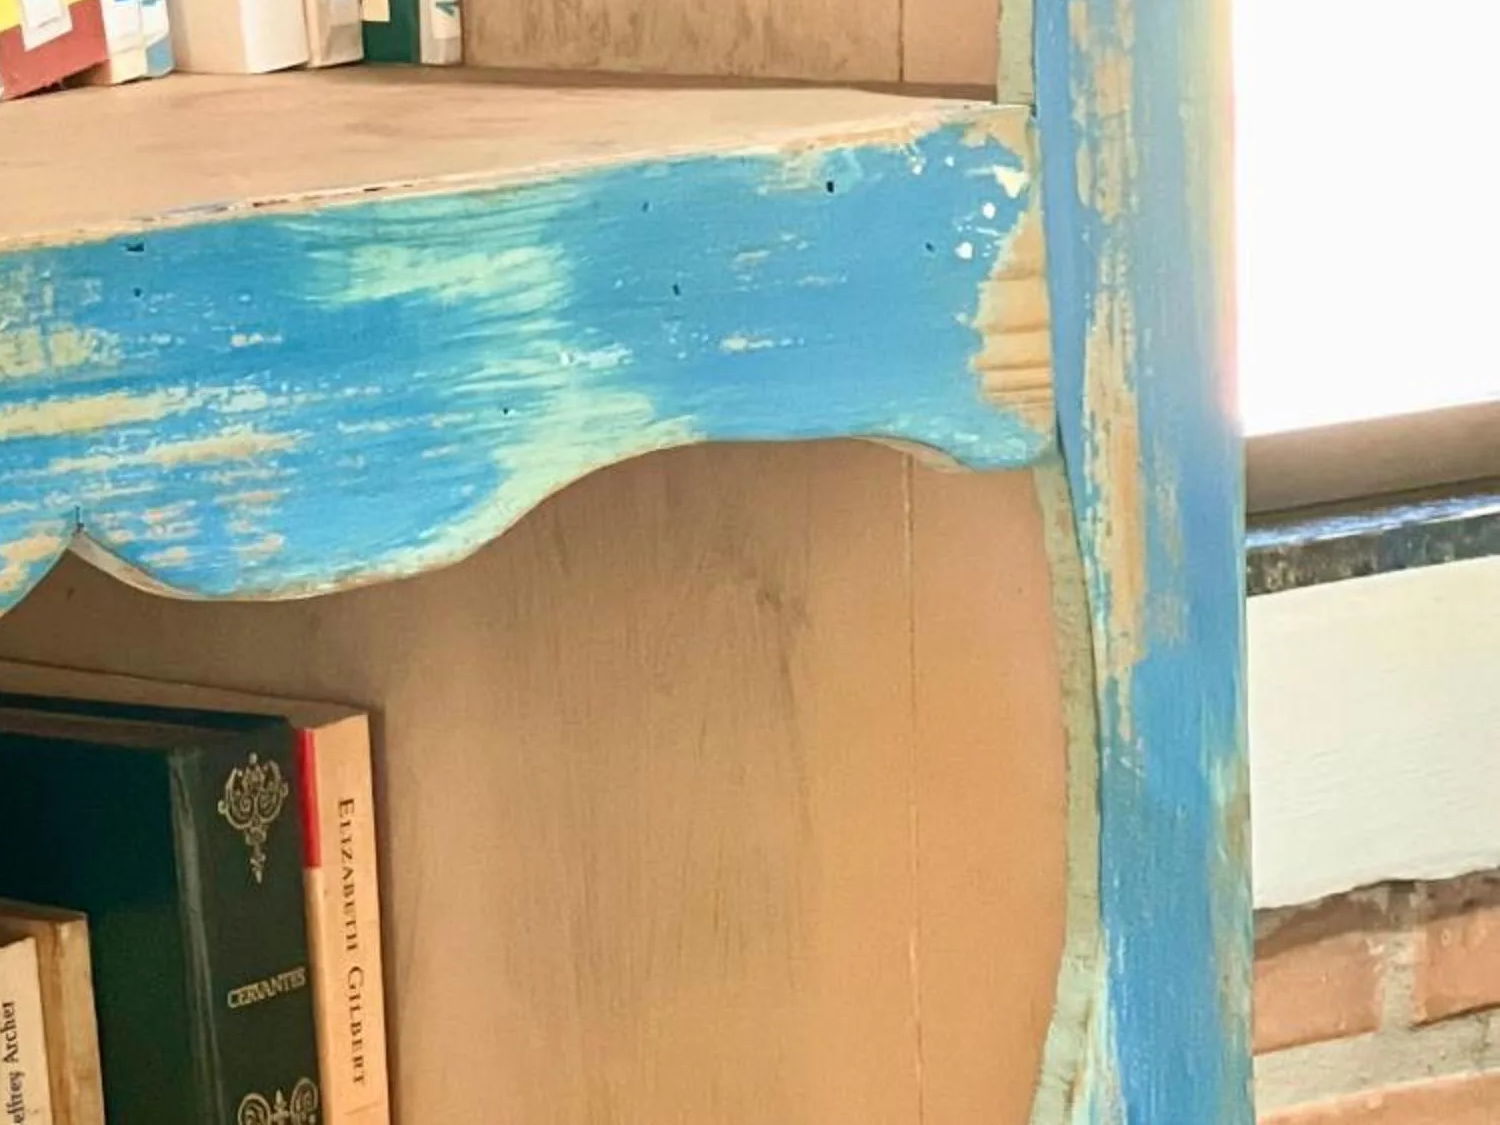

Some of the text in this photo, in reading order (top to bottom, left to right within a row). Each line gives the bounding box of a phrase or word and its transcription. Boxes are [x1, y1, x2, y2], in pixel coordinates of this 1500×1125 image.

[337, 797, 368, 1087] ELIZABETH GILBERT
[227, 967, 307, 1009] CERVANTES
[2, 1001, 17, 1063] Archer
